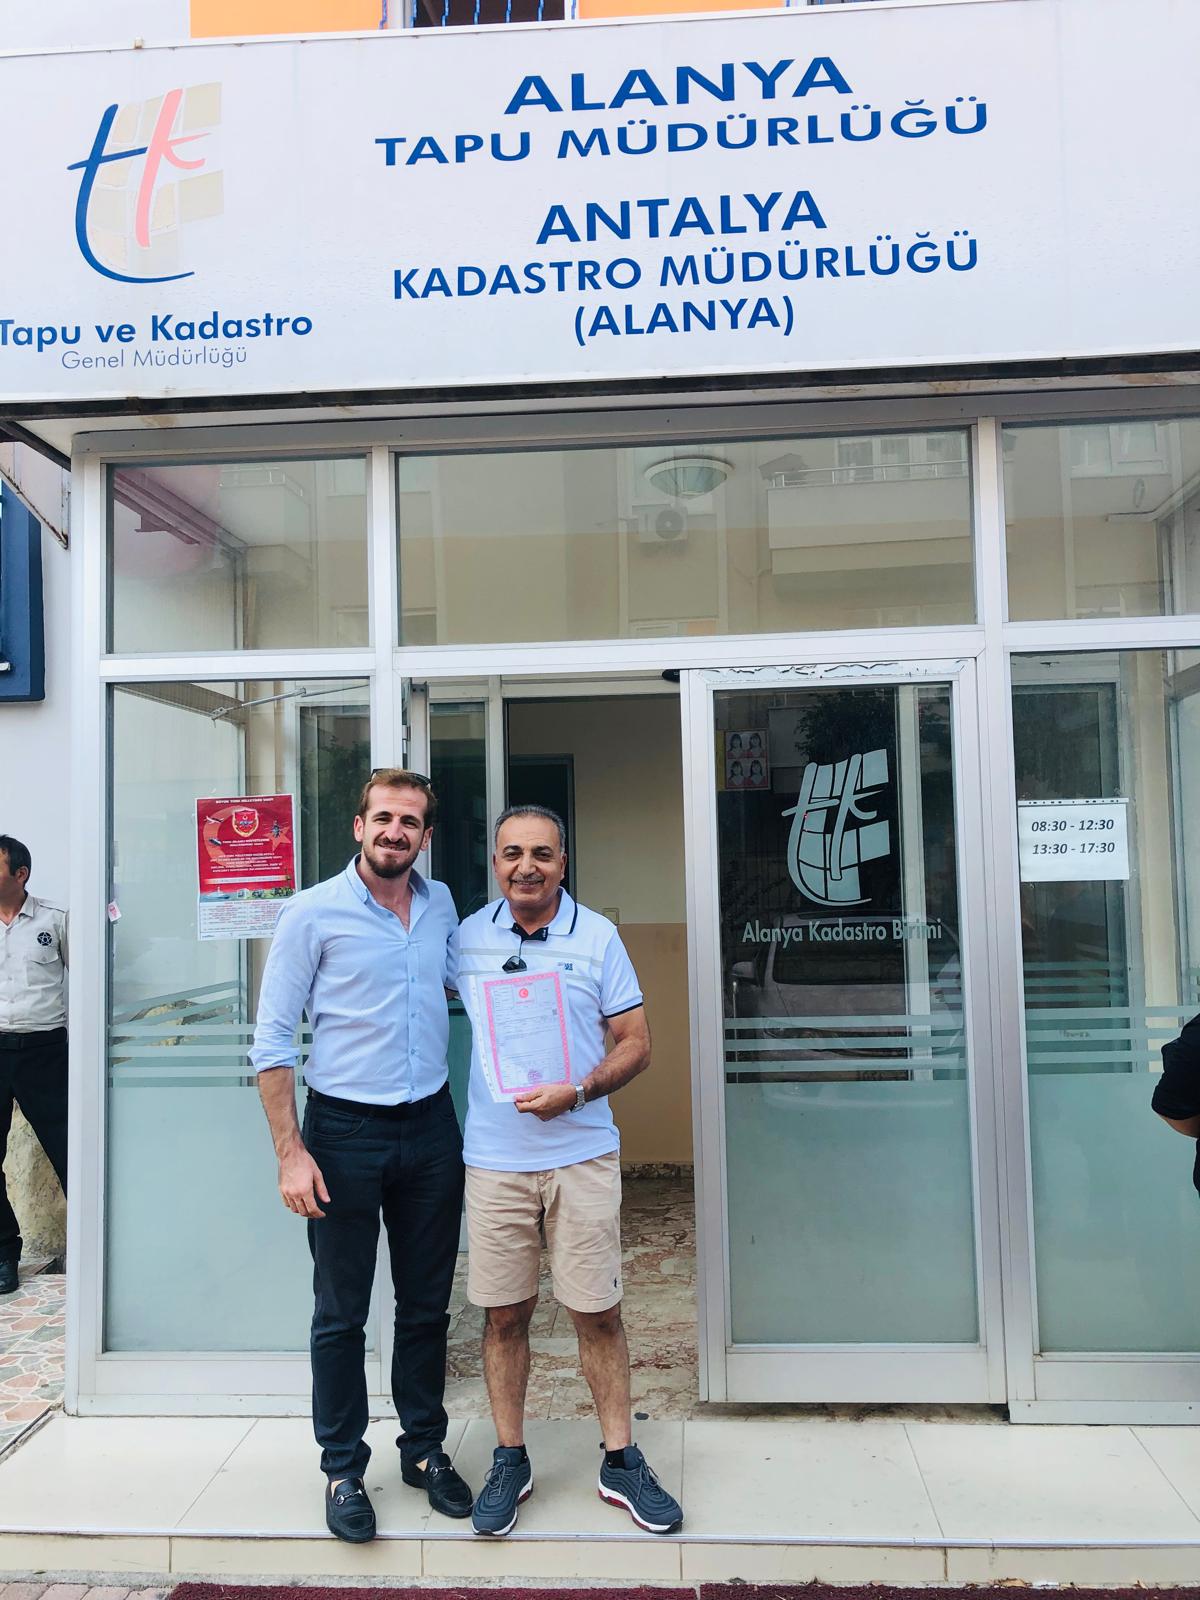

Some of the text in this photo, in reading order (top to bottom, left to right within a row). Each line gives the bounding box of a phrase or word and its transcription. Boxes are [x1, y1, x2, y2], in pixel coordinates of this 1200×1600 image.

[502, 56, 854, 116] ALANYA
[374, 95, 988, 167] TAPU MÜDÜRLÜĞÜ
[535, 189, 828, 246] ANTALYA
[393, 230, 979, 301] KADASTRO MÜDÜRLÜĞÜ
[0, 310, 314, 354] Tapu ve Kadastro
[574, 294, 795, 349] (ALANYA)
[61, 345, 248, 370] Genel Müdürlüğü
[1031, 820, 1068, 833] 08:30
[1078, 819, 1115, 831] 12:30
[1032, 843, 1069, 856] 13:30
[1079, 842, 1116, 854] 17:30
[742, 918, 942, 949] Alanya Kadastro Birimi
